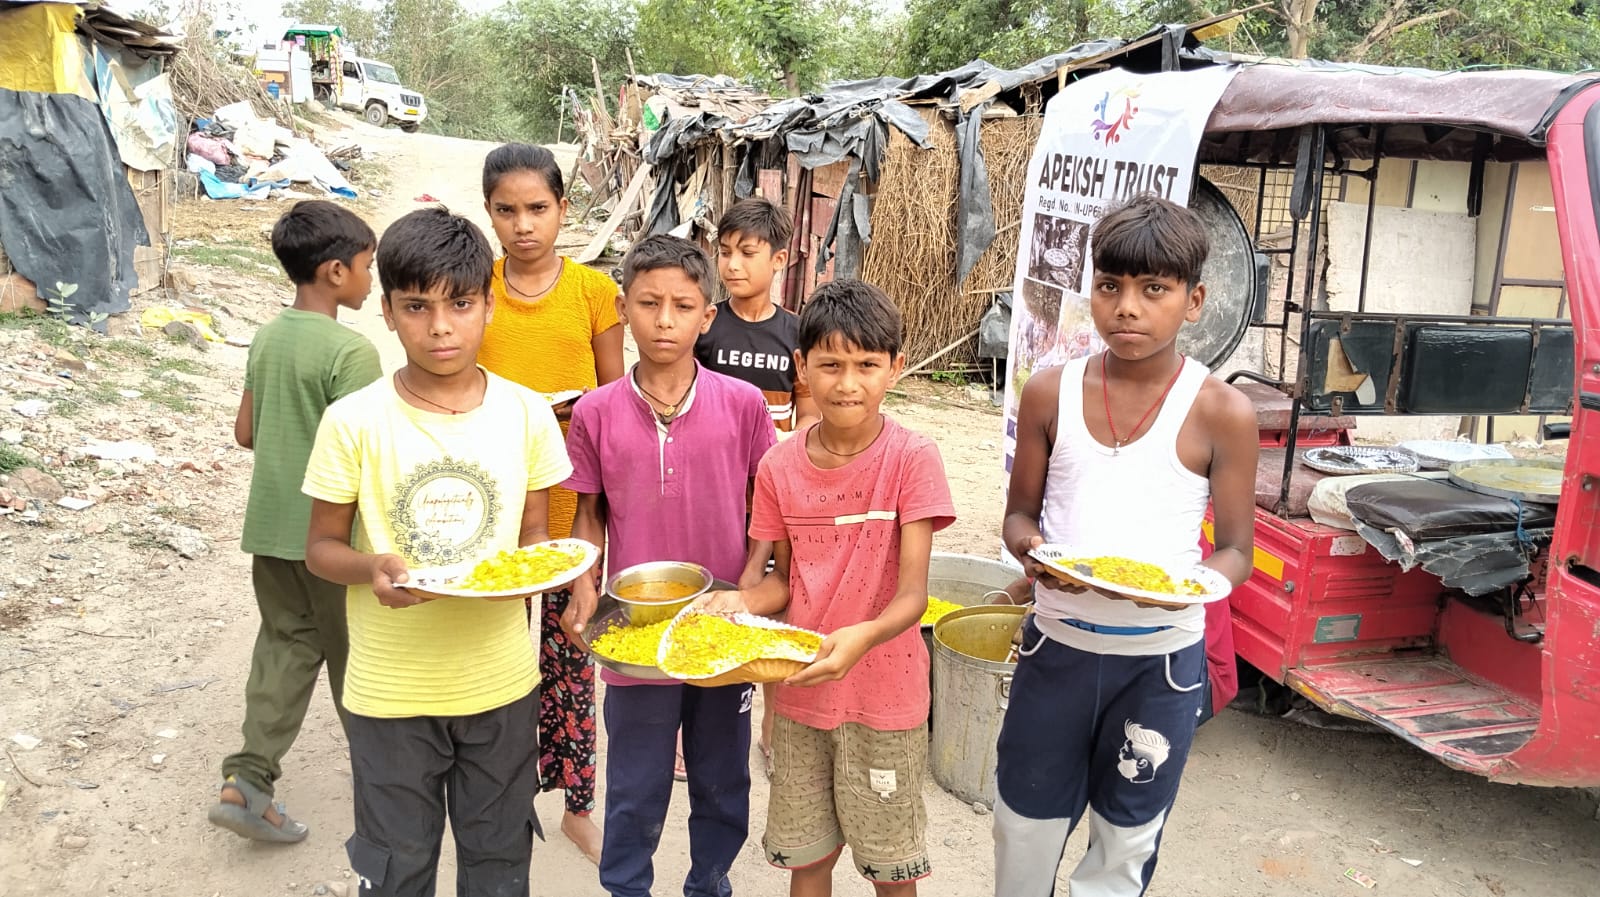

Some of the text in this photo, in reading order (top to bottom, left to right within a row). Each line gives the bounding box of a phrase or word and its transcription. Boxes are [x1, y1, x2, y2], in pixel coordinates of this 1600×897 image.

[1038, 152, 1179, 202] APEKSH TRUST
[717, 349, 790, 372] LEGEND
[806, 490, 863, 503] TOMM
